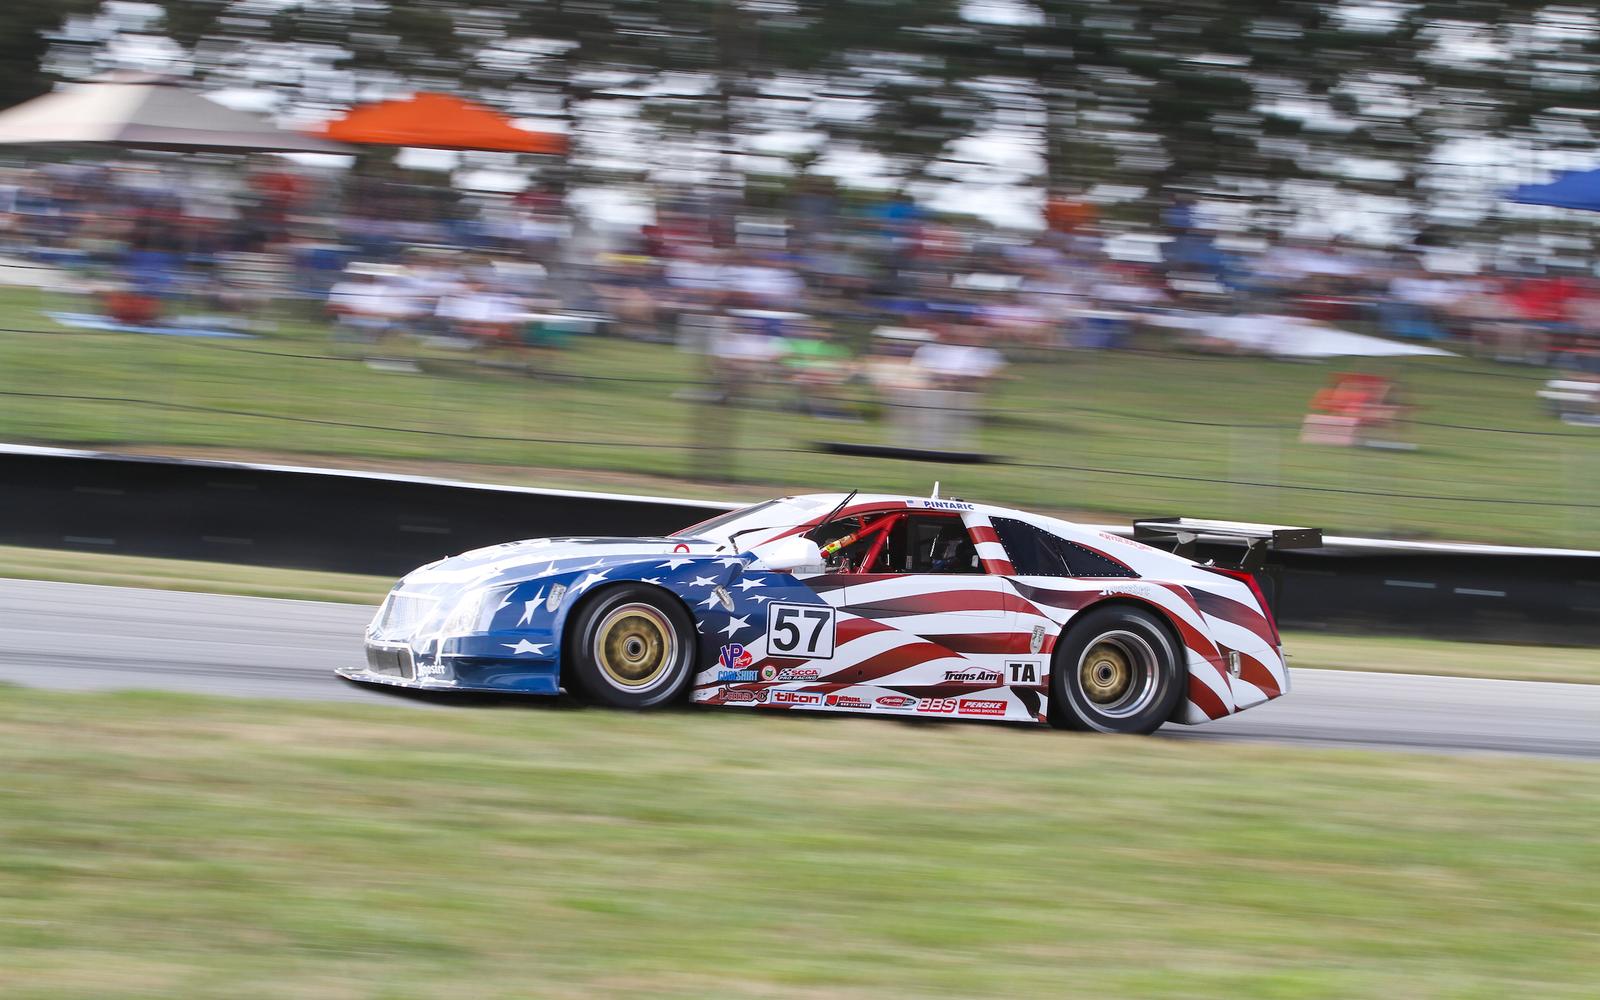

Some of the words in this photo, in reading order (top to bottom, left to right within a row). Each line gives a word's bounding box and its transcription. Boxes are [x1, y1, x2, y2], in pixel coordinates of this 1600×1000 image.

[923, 500, 975, 511] PINTARIC
[772, 608, 831, 653] 57
[720, 643, 744, 669] VP
[718, 670, 759, 681] COOLSHIRT
[944, 671, 975, 681] Trans
[976, 672, 997, 681] Am
[1009, 663, 1035, 683] TA
[774, 692, 819, 704] tilton
[918, 698, 957, 712] BBS
[963, 701, 1003, 709] PENSKE
